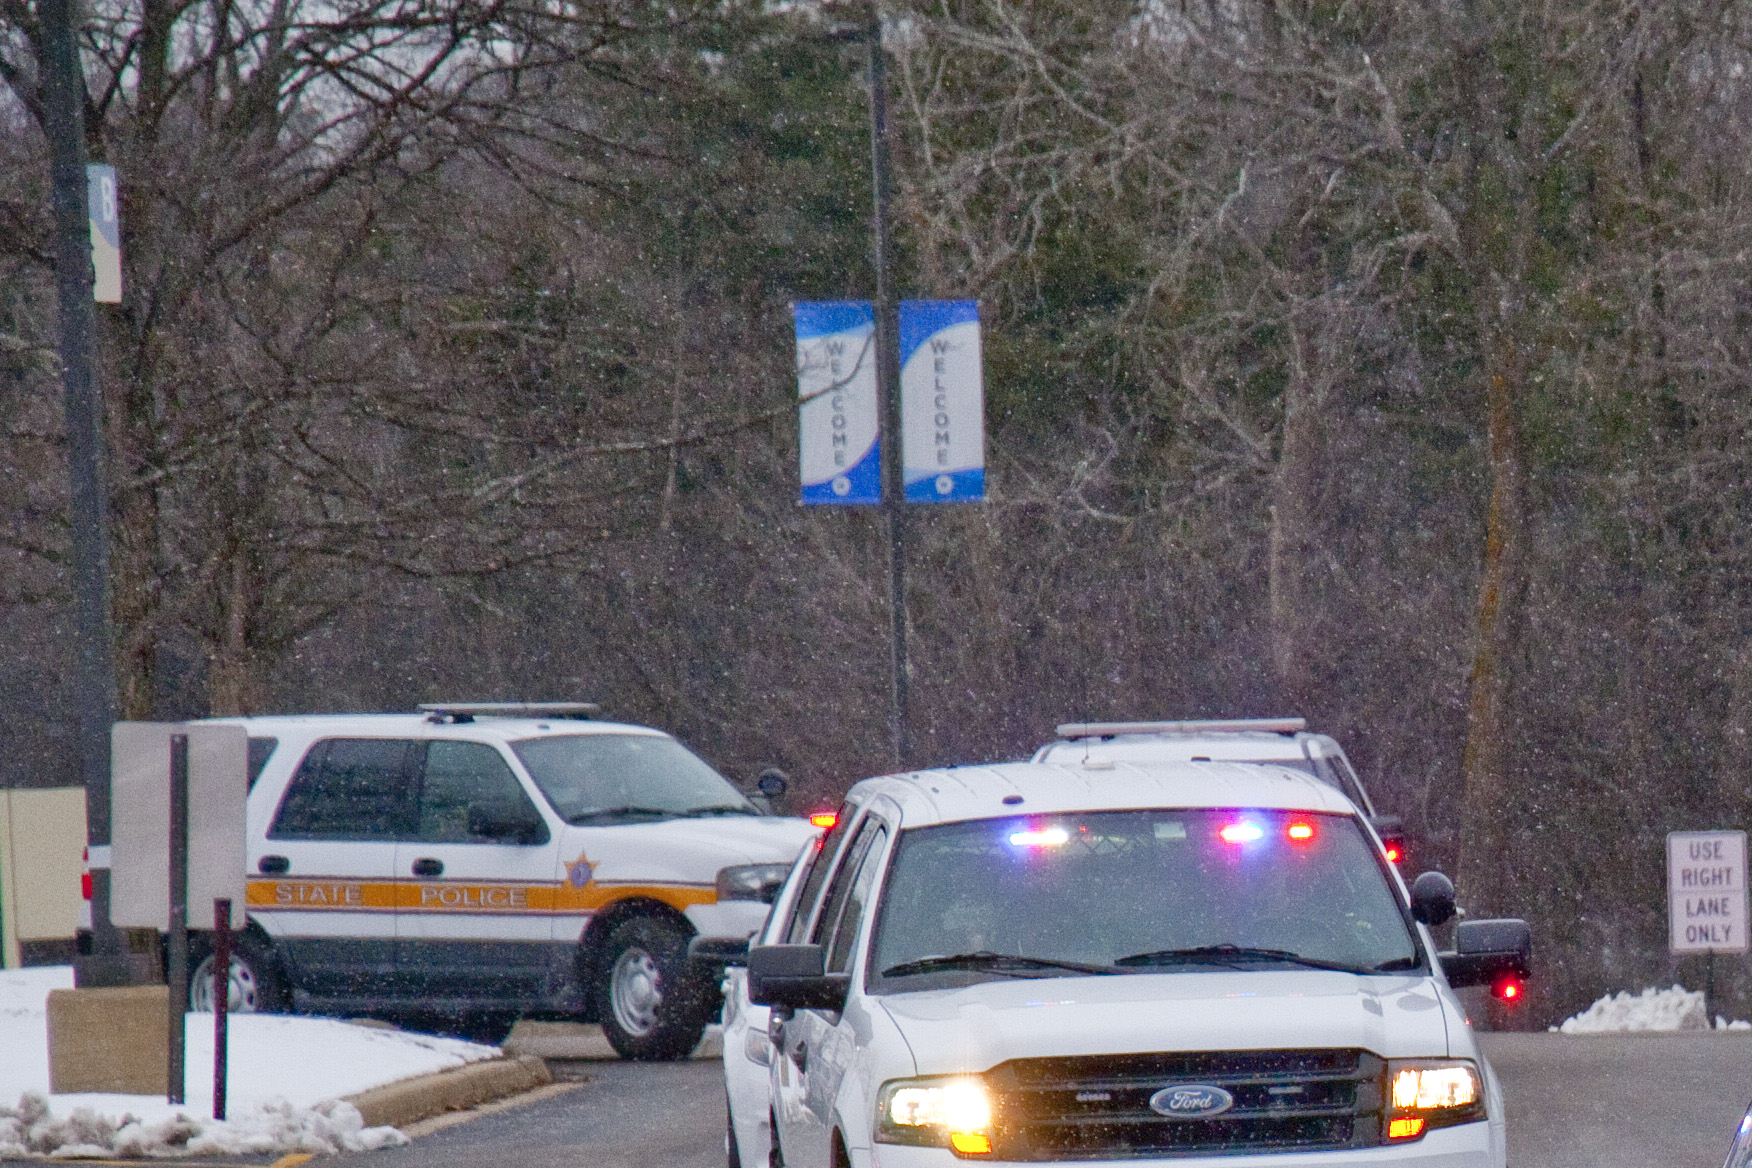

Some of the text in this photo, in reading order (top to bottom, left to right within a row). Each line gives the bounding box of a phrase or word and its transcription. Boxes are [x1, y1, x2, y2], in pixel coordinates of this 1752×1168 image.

[930, 339, 950, 466] WELCOME
[1689, 840, 1723, 860] USE
[1681, 866, 1733, 887] RIGHT
[275, 884, 528, 908] STATE POLICE
[1685, 897, 1731, 918] LANE
[1685, 924, 1732, 944] ONLY
[1170, 1091, 1212, 1110] Ford
